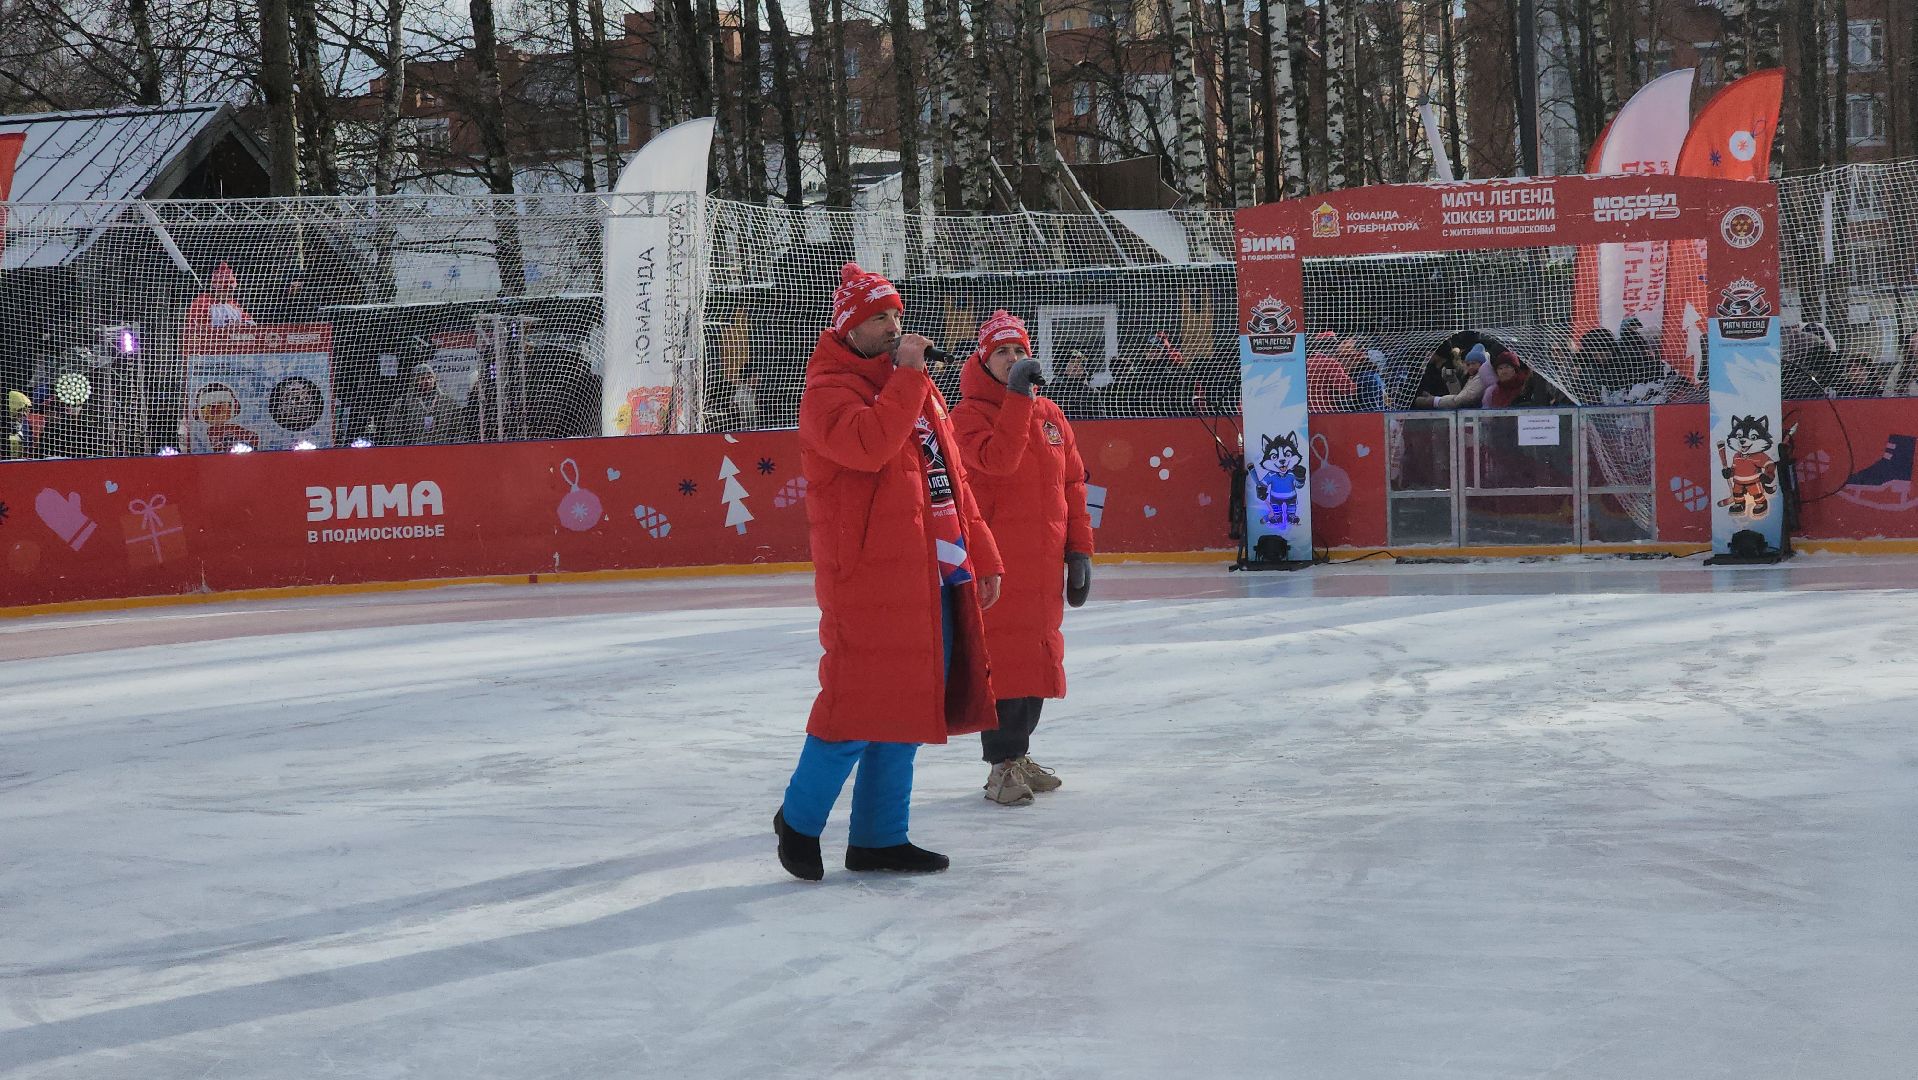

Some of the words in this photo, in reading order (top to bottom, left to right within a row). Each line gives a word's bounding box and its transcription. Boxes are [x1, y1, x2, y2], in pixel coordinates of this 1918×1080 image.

[1442, 191, 1485, 208] МАТЧ
[1490, 187, 1555, 206] ЛЕГЕНД
[1593, 193, 1677, 210] МОСОБЛ
[1346, 211, 1400, 221] КОМАНДА
[1443, 210, 1495, 225] ХОККЕЯ
[1499, 207, 1556, 222] РОССИИ
[1594, 207, 1661, 222] СПОРТ
[1346, 222, 1421, 234] ГУБЕРНАТОРА
[1442, 229, 1448, 237] С
[1450, 227, 1494, 237] ЖИТЕЛЯМИ
[1495, 224, 1556, 235] ПОДМОСКОВЬЯ
[1241, 235, 1295, 252] ЗИМА
[635, 246, 655, 365] КОМАНДА
[1722, 322, 1740, 330] МАТЧ
[1742, 320, 1766, 328] ЛЕГЕНД
[305, 480, 444, 522] ЗИМА
[307, 530, 319, 544] В
[322, 524, 445, 544] ПОДМОСКОВЬЕ
